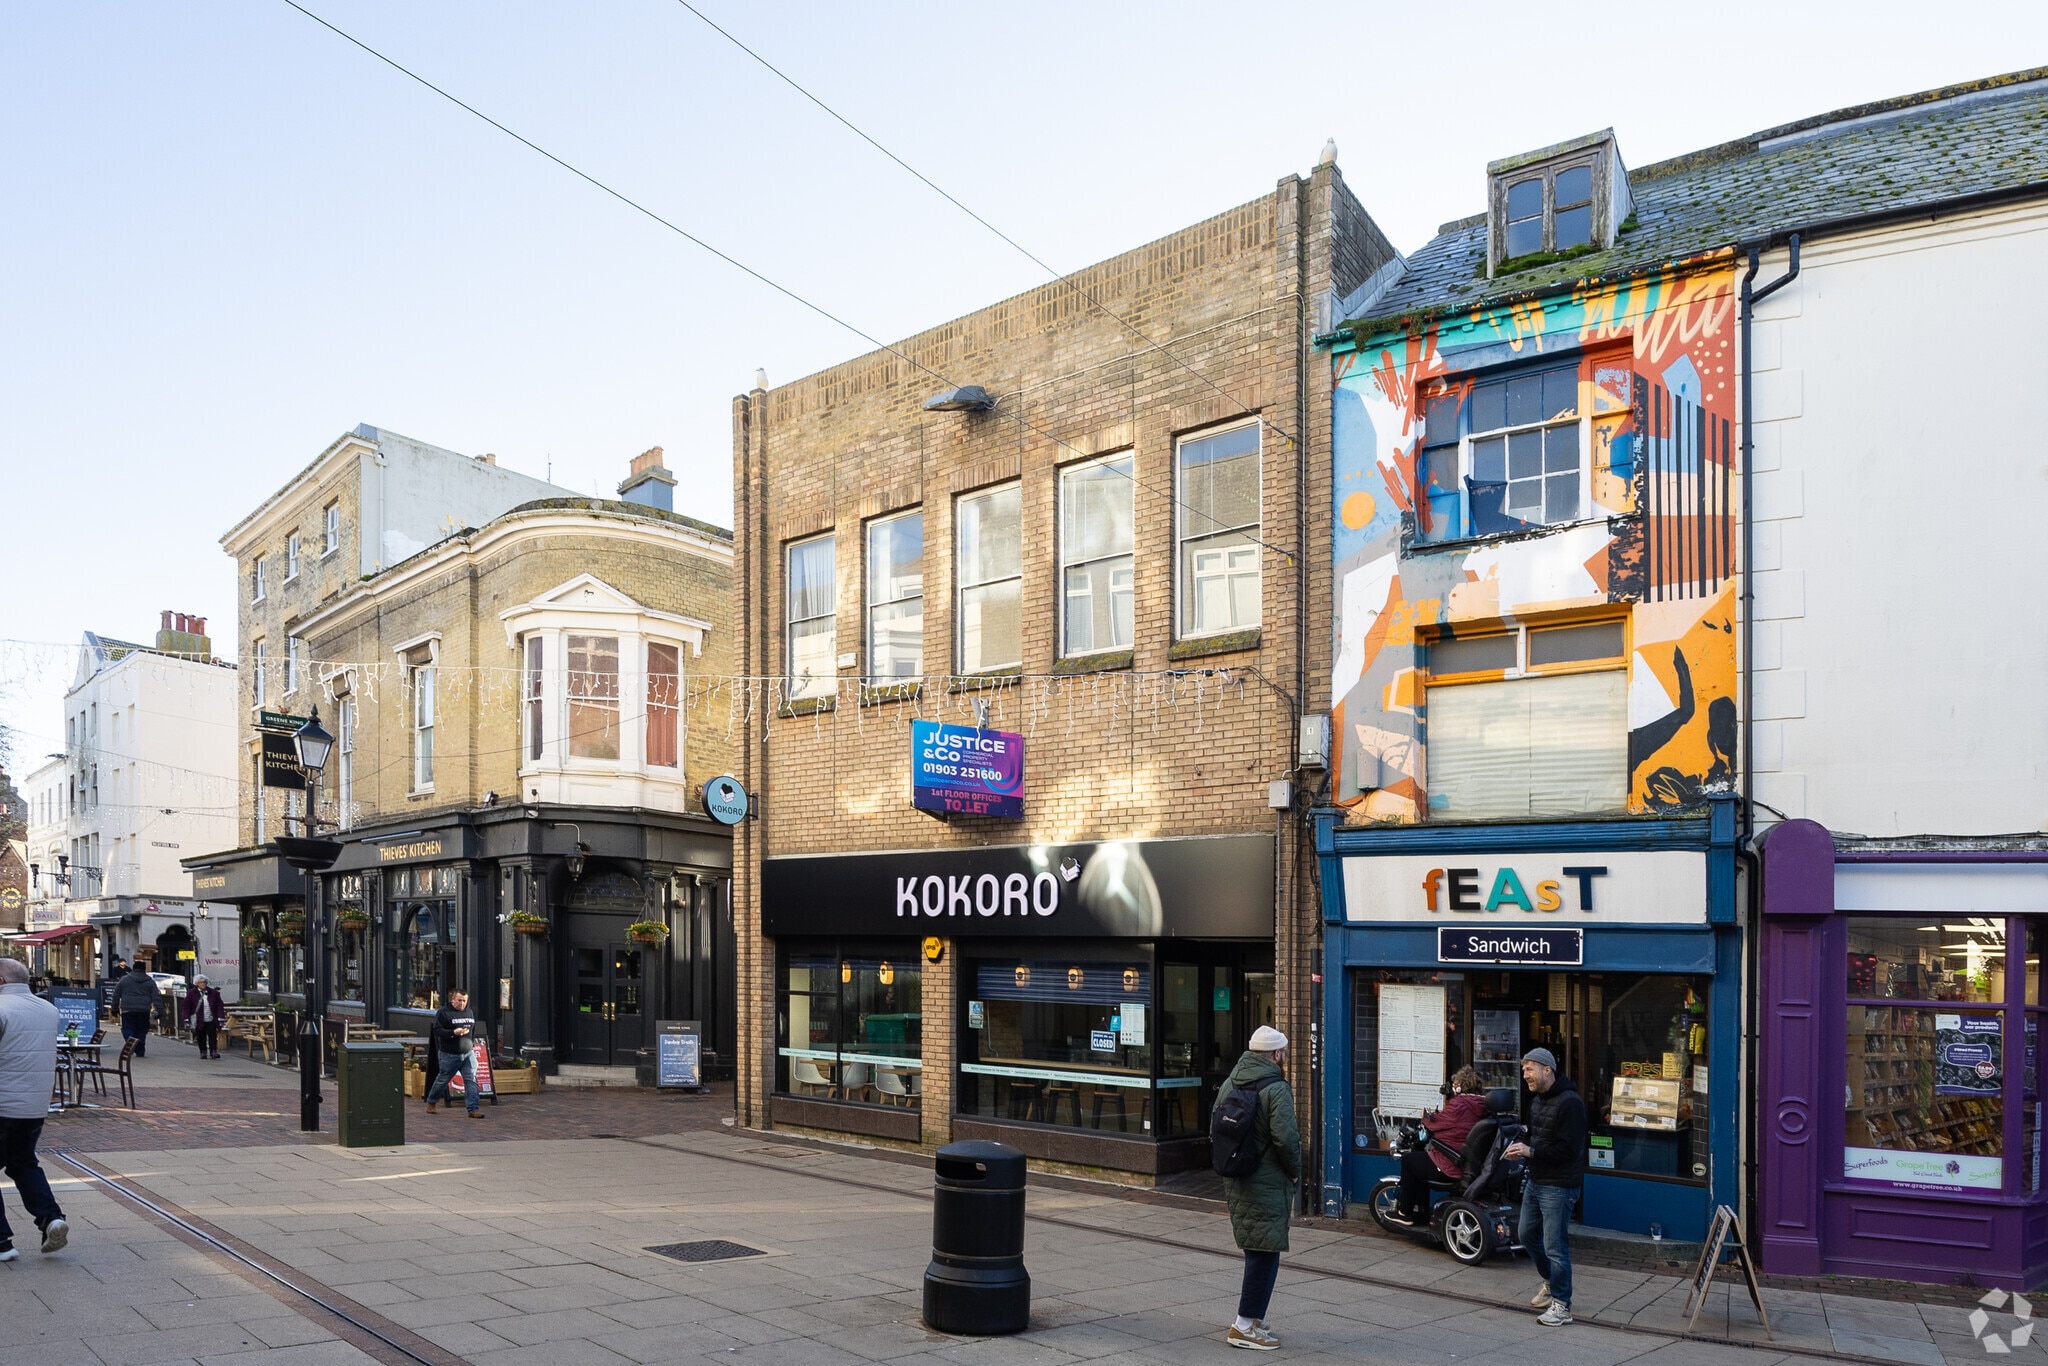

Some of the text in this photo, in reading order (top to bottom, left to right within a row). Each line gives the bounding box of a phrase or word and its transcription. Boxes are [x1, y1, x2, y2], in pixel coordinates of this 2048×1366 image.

[266, 716, 288, 724] GREENE
[923, 732, 1006, 754] JUSTICE
[266, 751, 299, 762] THIEVE
[923, 747, 960, 762] &Co
[962, 750, 993, 758] COMMERCIAL
[923, 762, 1002, 781] 01903 251600
[931, 788, 1002, 803] 1st FLOOR OFFICES
[712, 804, 744, 816] KOKORO
[944, 798, 989, 814] TO LET
[409, 840, 442, 858] KITCHEN
[210, 876, 226, 887] KITCHEN
[1422, 866, 1608, 912] fEAsT
[896, 872, 1059, 917] KOKORO
[1468, 936, 1550, 954] Sandwich
[1093, 1038, 1113, 1049] CLOSED
[1621, 1062, 1662, 1078] FRES
[1844, 1156, 1888, 1172] Superfoods
[1896, 1160, 1944, 1171] Grape Tree
[1893, 1181, 1963, 1192] www.grapetree.co.uk
